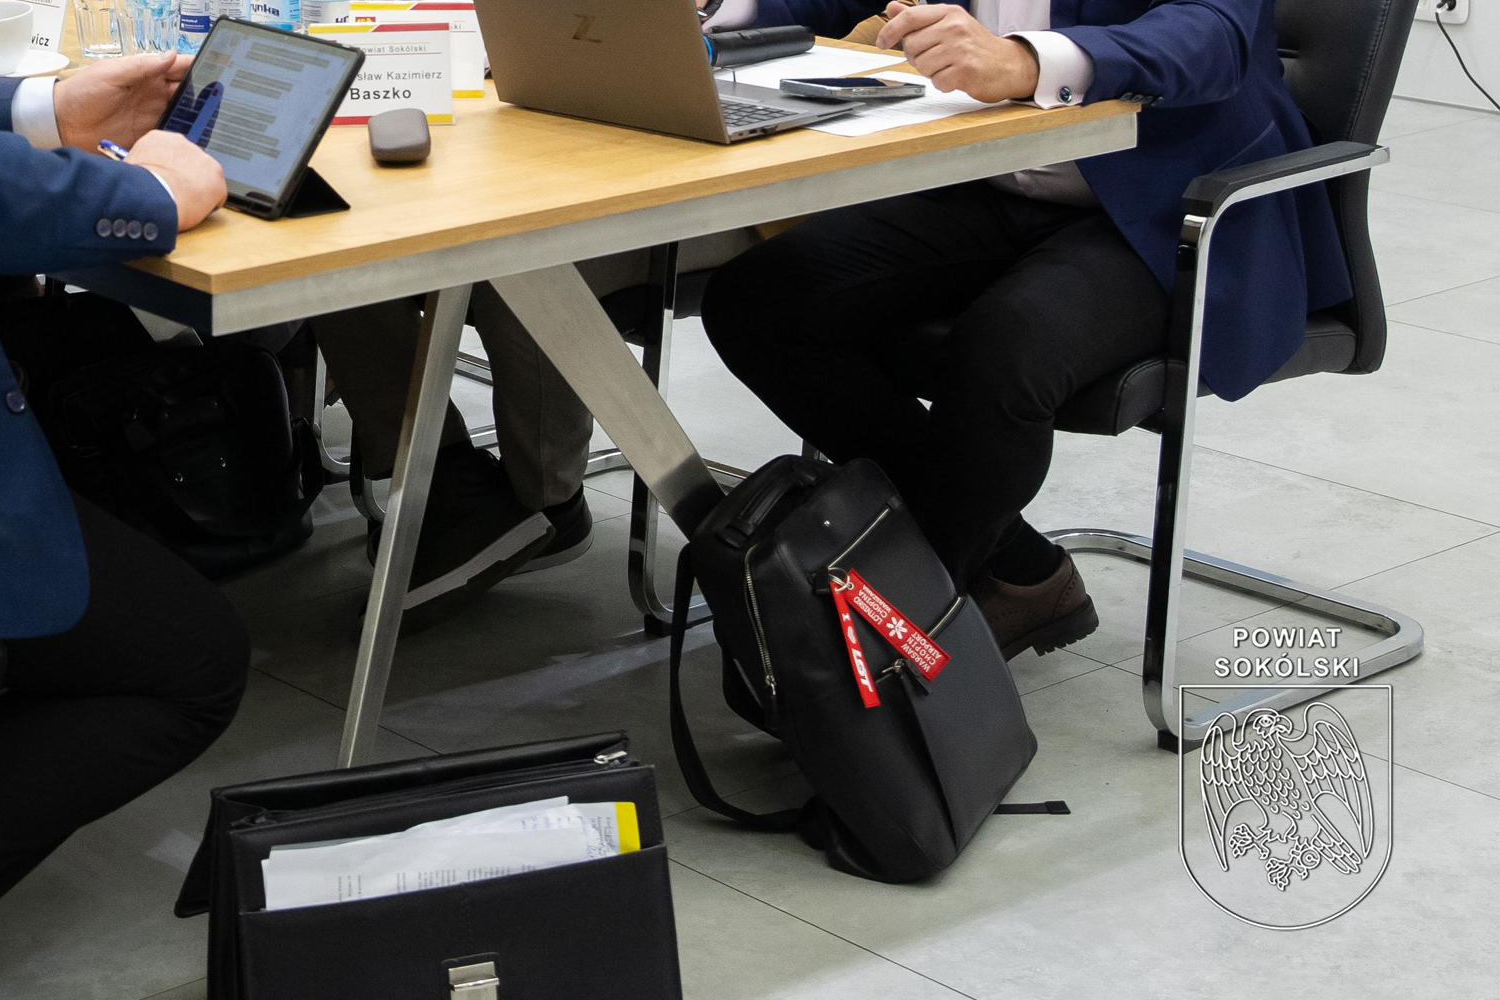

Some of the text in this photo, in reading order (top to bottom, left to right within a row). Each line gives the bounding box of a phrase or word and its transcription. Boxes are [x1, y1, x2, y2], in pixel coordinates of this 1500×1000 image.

[361, 44, 427, 54] owiat Sokólski
[386, 70, 443, 81] Kazimierz
[350, 86, 412, 101] Baszko
[853, 595, 883, 625] LOTNISKO
[858, 589, 888, 619] CHOPINA
[900, 642, 931, 673] WARSAW
[906, 636, 937, 666] CHOPIN
[911, 631, 942, 660] AIRPORT
[851, 647, 873, 693] LOT
